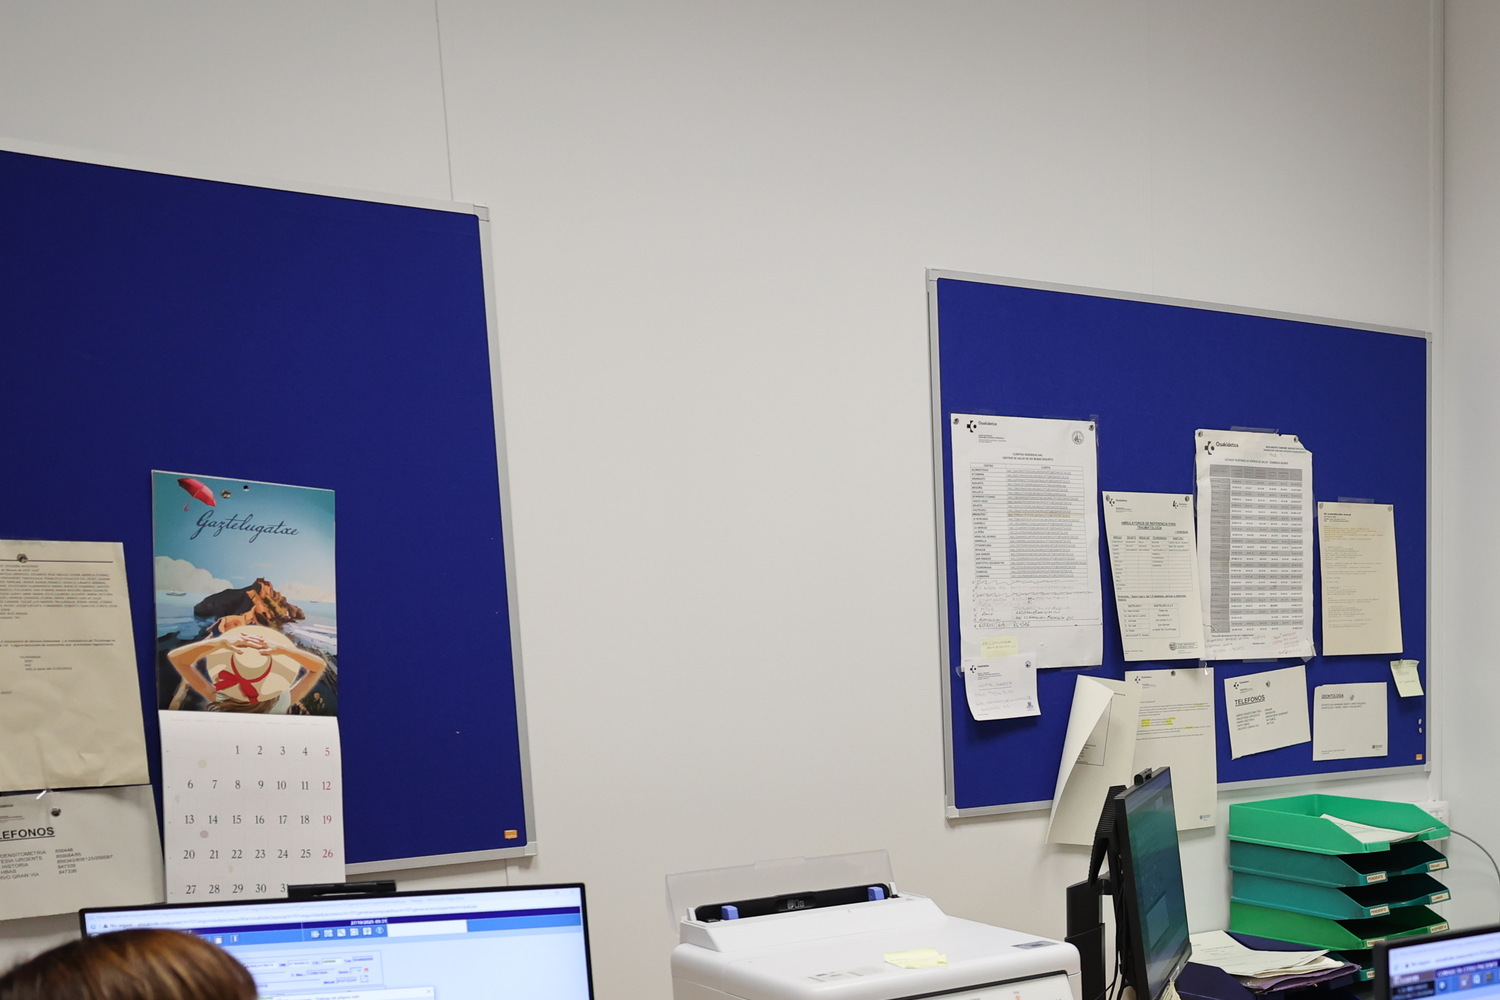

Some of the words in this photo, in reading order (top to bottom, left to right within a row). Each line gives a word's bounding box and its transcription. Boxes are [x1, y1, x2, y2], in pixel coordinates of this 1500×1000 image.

[190, 509, 299, 543] Gaztelugatxe
[1234, 694, 1266, 706] TELEFONOS
[236, 745, 240, 755] 1
[257, 745, 263, 755] 2
[280, 746, 286, 756] 3
[302, 746, 308, 756] 4
[325, 747, 330, 756] 5
[187, 779, 194, 789] 6
[212, 779, 218, 789] 7
[234, 779, 241, 789] 8
[258, 779, 264, 790] 9
[277, 780, 287, 790] 10
[301, 780, 309, 790] 11
[321, 781, 331, 791] 12
[184, 814, 195, 824] 13
[208, 814, 218, 824] 14
[232, 814, 242, 824] 15
[255, 814, 265, 824] 16
[279, 814, 287, 824] 17
[300, 814, 310, 824] 18
[322, 814, 332, 824] 19
[183, 849, 195, 860] 20
[209, 849, 219, 860] 21
[231, 849, 243, 859] 22
[255, 849, 266, 859] 23
[277, 849, 288, 859] 24
[300, 849, 311, 859] 25
[322, 849, 333, 859] 26
[185, 884, 196, 895] 27
[208, 884, 220, 894] 28
[232, 883, 244, 894] 29
[255, 883, 267, 893] 30
